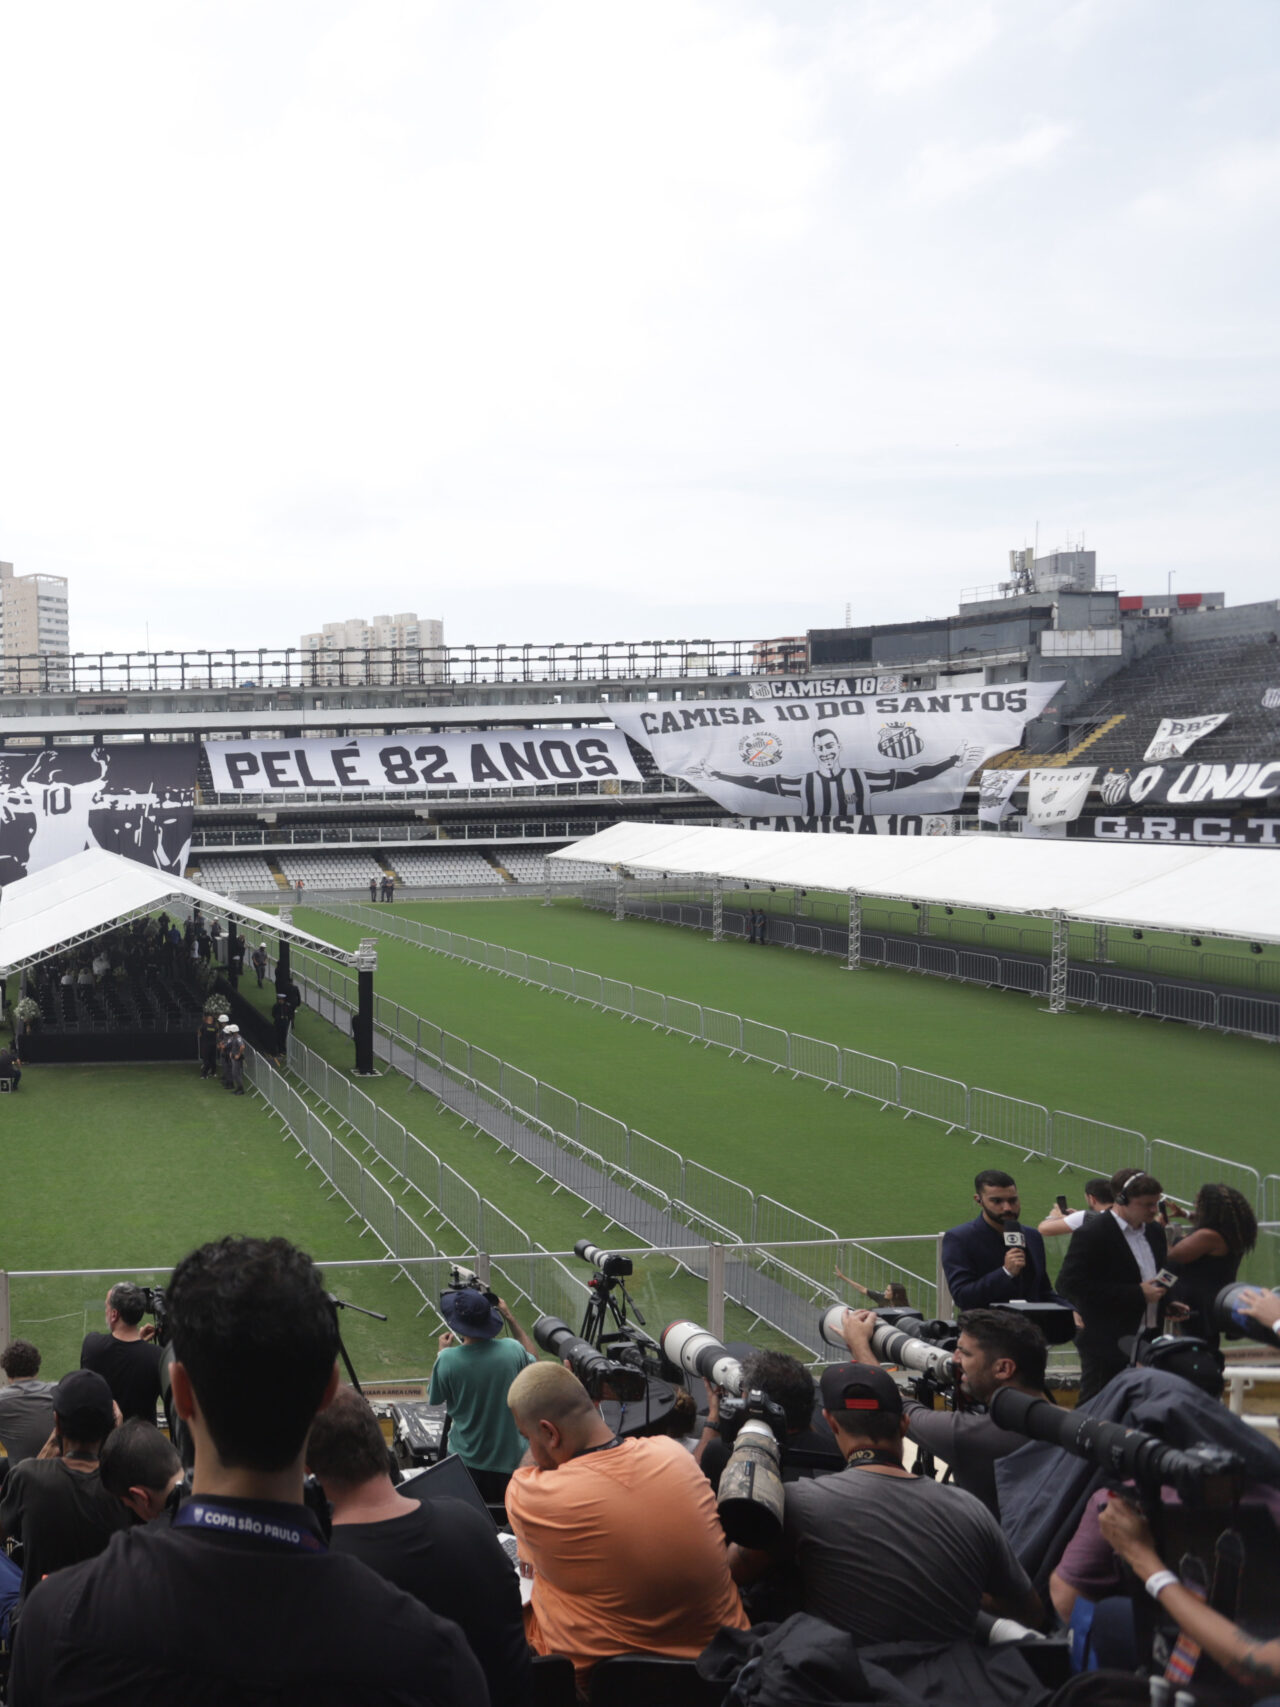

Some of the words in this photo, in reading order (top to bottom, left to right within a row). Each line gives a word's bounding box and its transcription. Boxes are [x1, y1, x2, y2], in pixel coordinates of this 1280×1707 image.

[770, 679, 854, 698] CAMISA
[856, 678, 875, 694] 10
[639, 706, 765, 735] CAMISA
[775, 704, 809, 721] 10
[816, 700, 865, 719] DO
[876, 688, 1027, 713] SANTOS
[225, 741, 370, 788] PELÉ
[379, 745, 457, 785] 82
[472, 738, 617, 782] ANOS
[42, 785, 72, 816] 10
[204, 1511, 236, 1528] COPA
[238, 1516, 263, 1534] SÃO
[264, 1525, 300, 1543] PAULO
